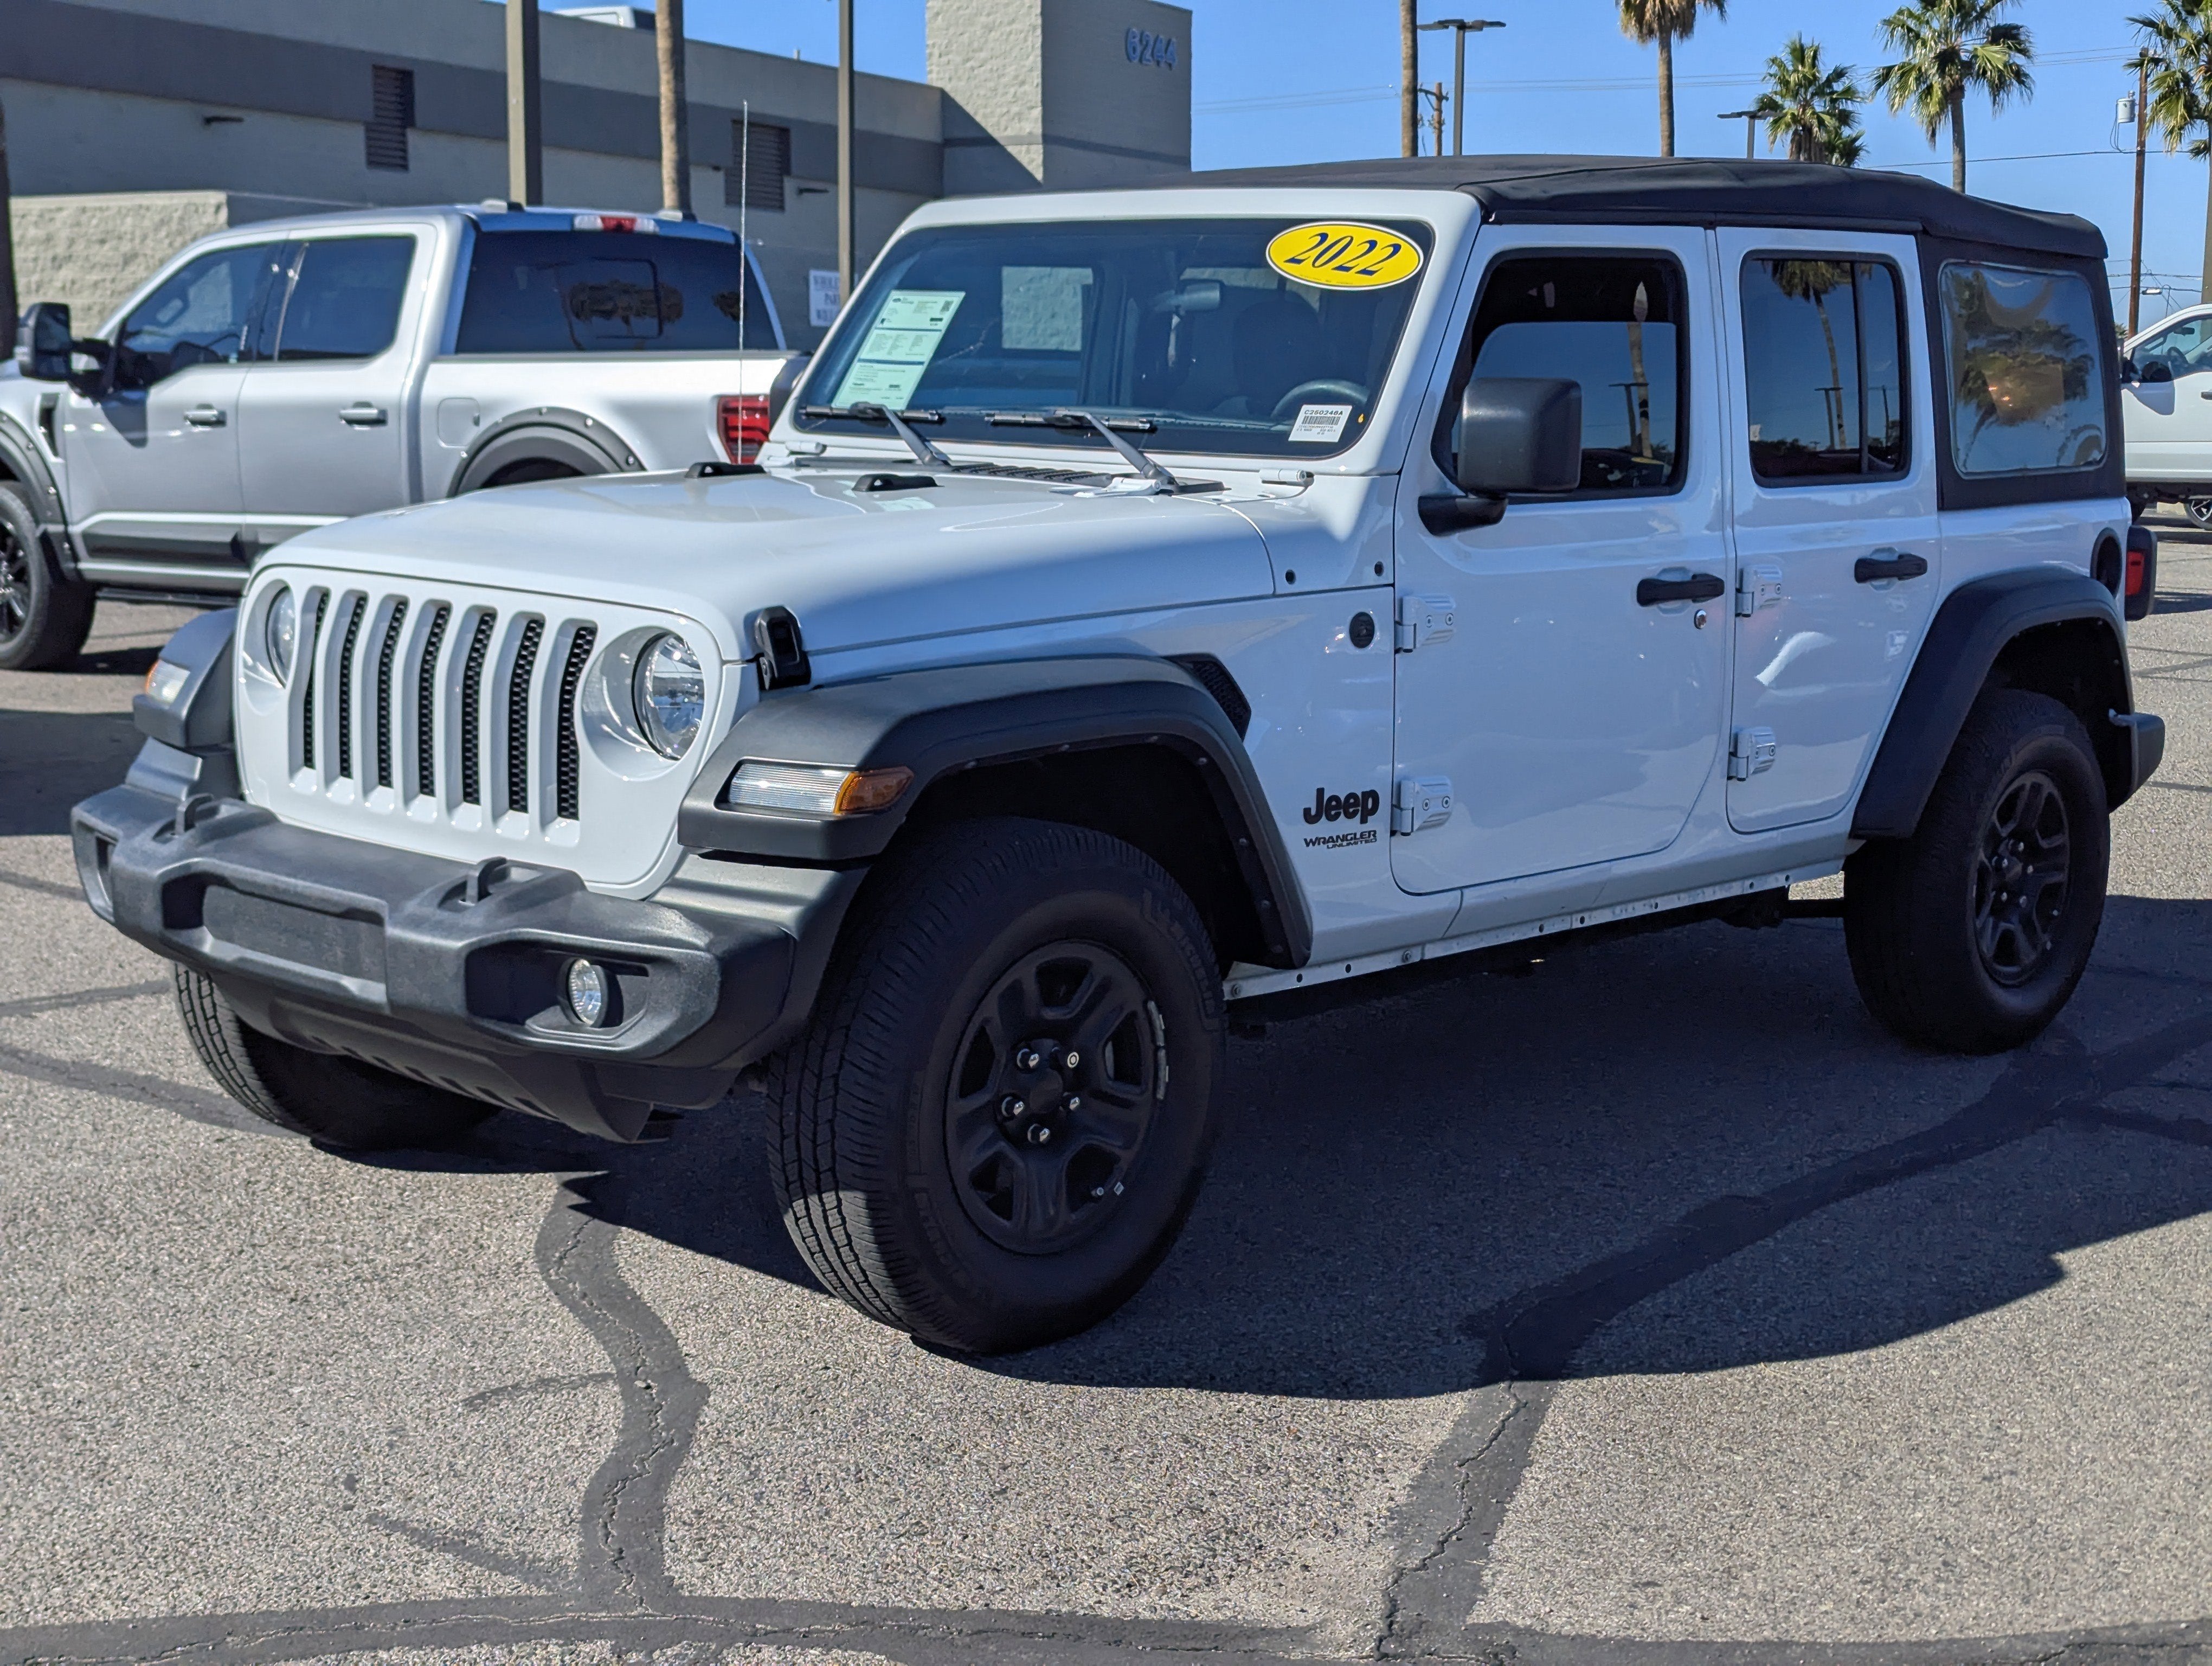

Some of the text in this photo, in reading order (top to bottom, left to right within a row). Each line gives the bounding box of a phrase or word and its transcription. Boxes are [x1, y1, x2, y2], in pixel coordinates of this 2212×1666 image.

[1126, 27, 1178, 70] 6244
[1283, 232, 1401, 277] 2022
[1303, 787, 1380, 824] Jeep
[1303, 830, 1377, 848] WRANGLER
[1326, 838, 1377, 849] UNLIMITED
